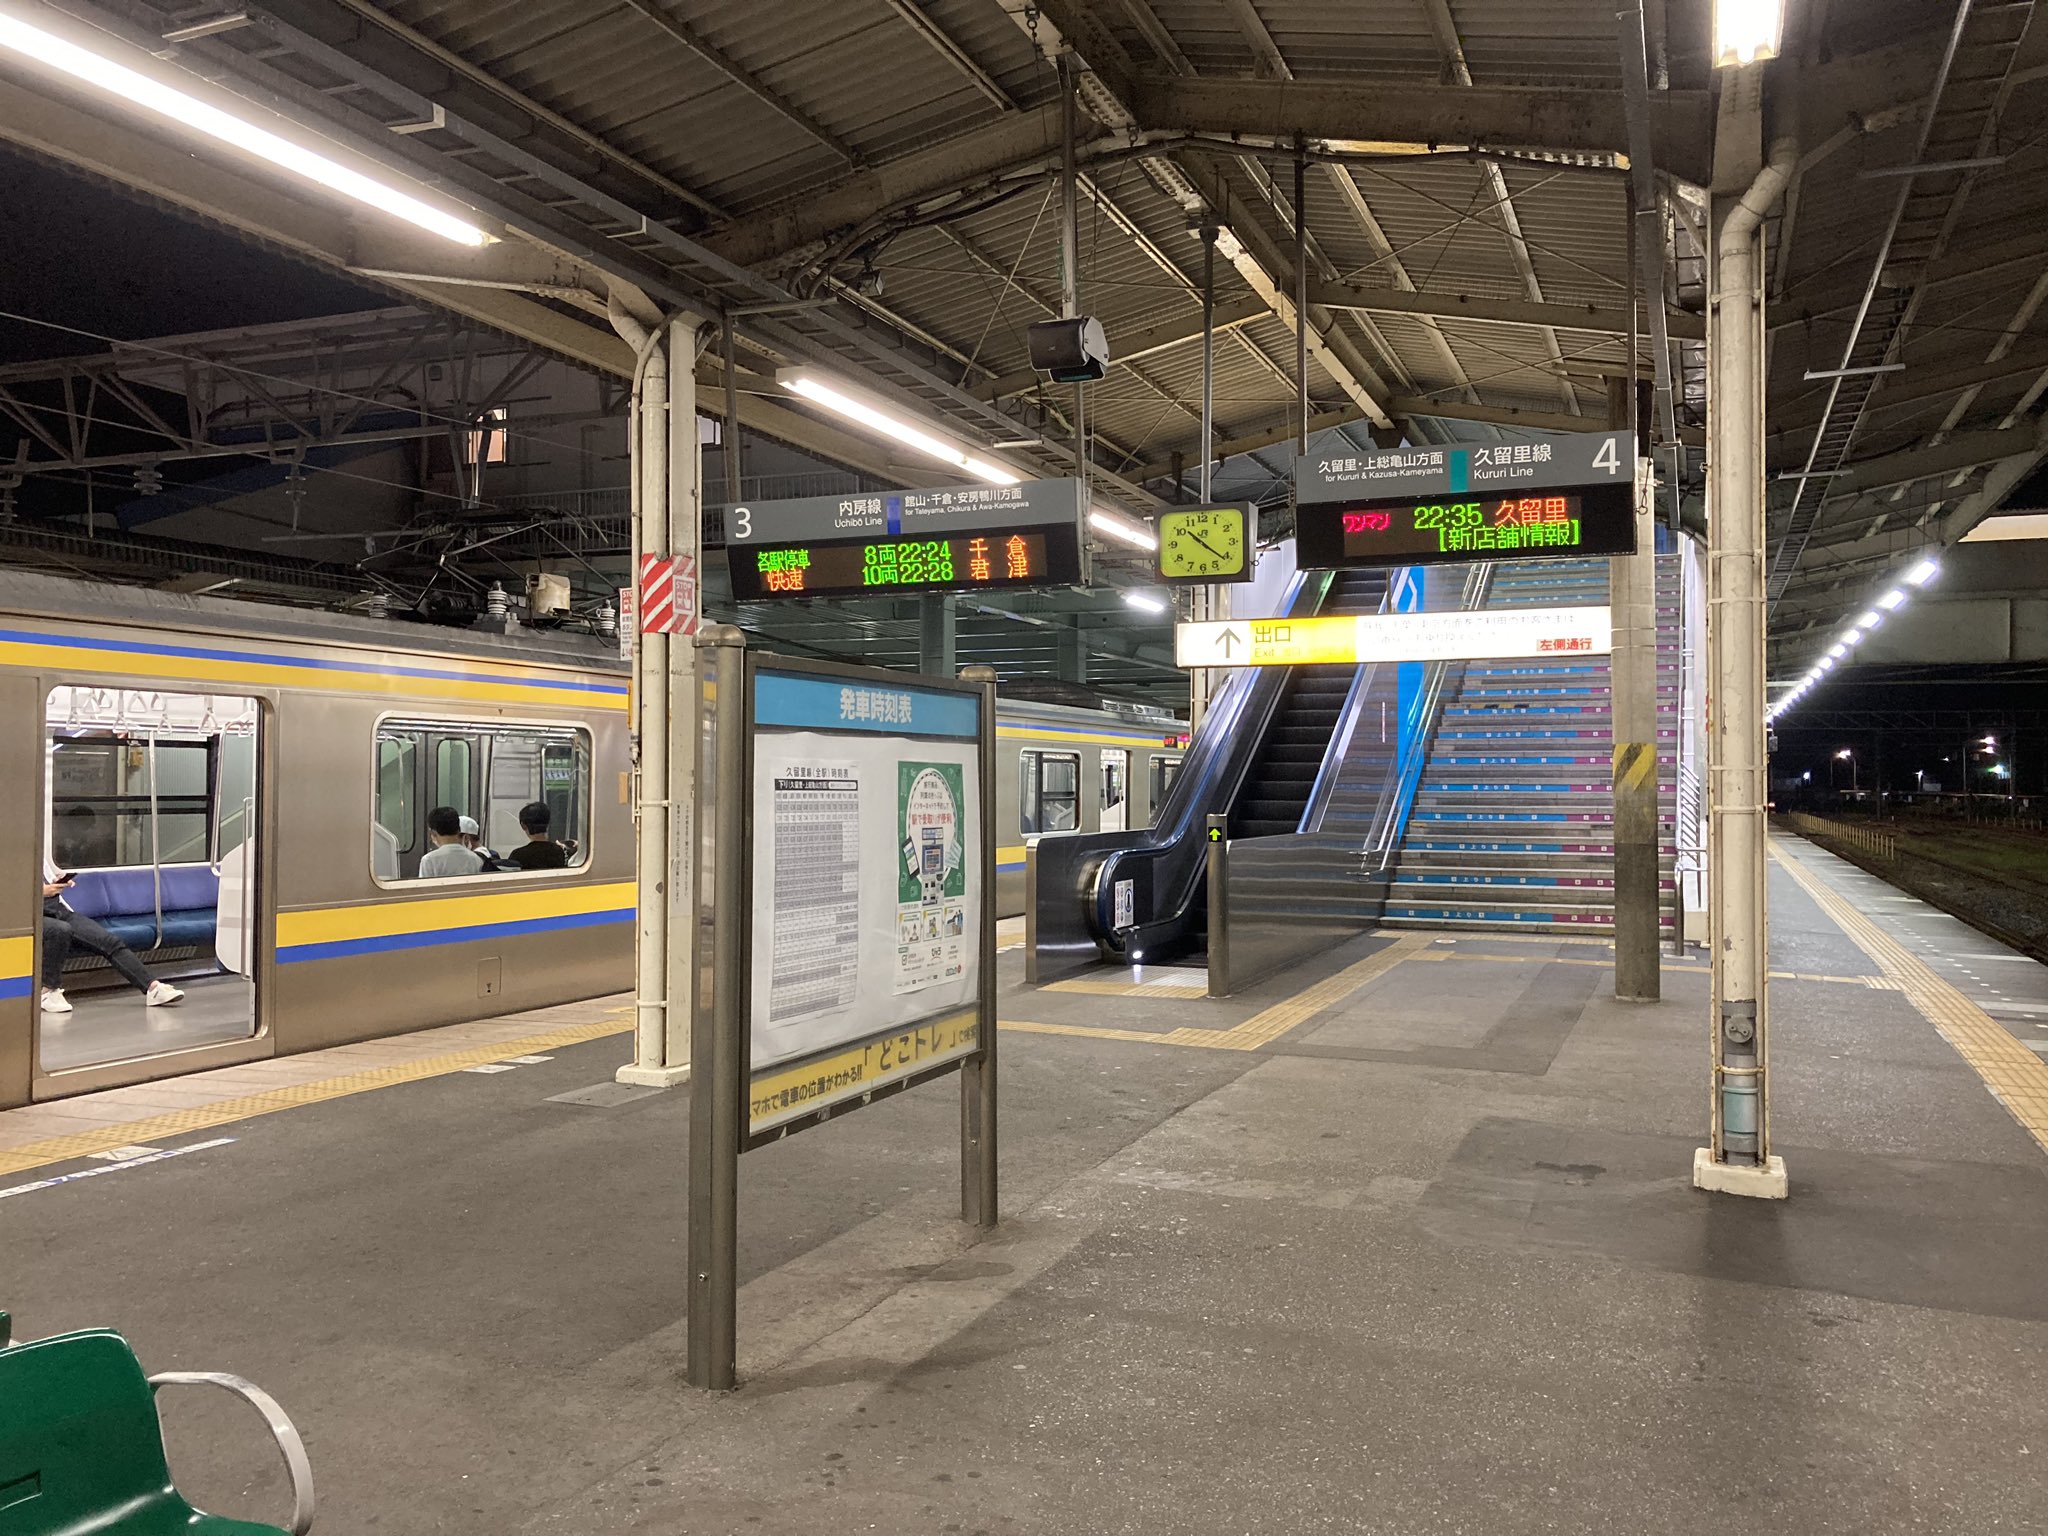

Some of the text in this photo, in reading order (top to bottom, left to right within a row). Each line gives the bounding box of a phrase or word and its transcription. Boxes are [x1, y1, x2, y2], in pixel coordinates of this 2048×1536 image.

[1318, 452, 1443, 474] 久留里・上総亀山方面
[1474, 444, 1552, 467] 久留里線
[1592, 438, 1621, 475] 4
[1325, 474, 1335, 482] for
[1337, 472, 1360, 481] Kururi
[1369, 467, 1443, 479] Kazusa-Kameyama
[1474, 467, 1534, 480] Kururi Line
[839, 498, 882, 517] 内房線
[905, 508, 914, 516] for
[947, 505, 971, 513] Chikura
[979, 501, 1029, 510] Awa-Kamogawa
[1342, 497, 1568, 532] ワンマン 22:35 久留里
[735, 507, 752, 539] 3
[865, 516, 883, 526] Line
[1186, 519, 1195, 527] 11
[1197, 515, 1208, 523] 12
[1176, 528, 1186, 536] 10
[757, 549, 811, 572] 各駅停車
[864, 544, 898, 565] 8両
[898, 541, 952, 563] 22:24
[767, 569, 804, 591] 快速
[862, 564, 898, 585] 10両
[900, 562, 953, 583] 22:28
[1255, 626, 1291, 643] 出口
[1254, 648, 1275, 658] Exit
[1539, 638, 1592, 651] 左側通行
[840, 688, 912, 723] 発車時刻表
[750, 1064, 863, 1116] マホで電車の位置がわかる!!
